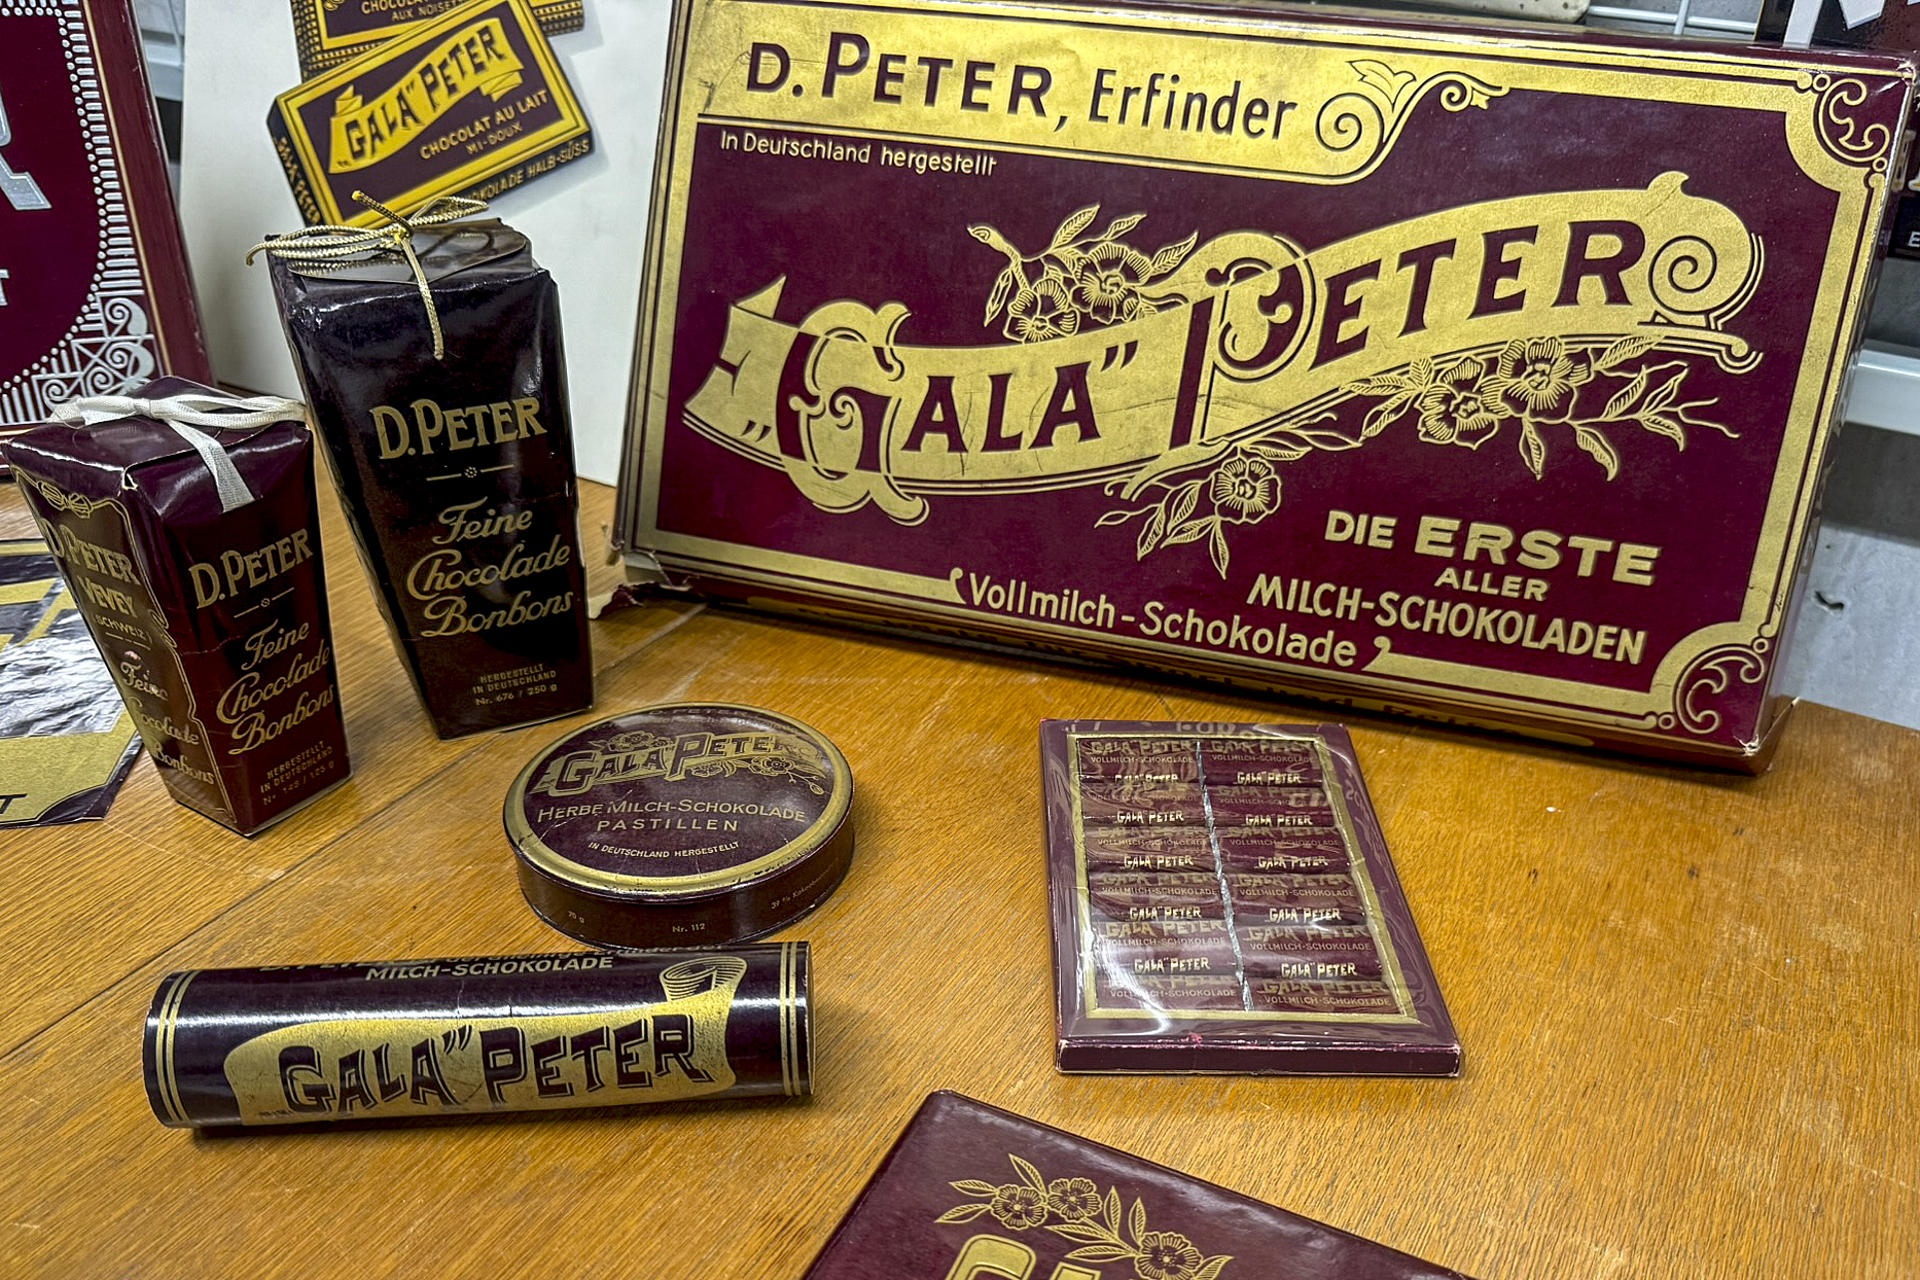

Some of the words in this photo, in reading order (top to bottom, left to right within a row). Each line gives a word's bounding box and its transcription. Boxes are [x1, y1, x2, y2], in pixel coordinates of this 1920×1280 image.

[422, 25, 507, 112] PETER
[746, 42, 804, 98] D.
[820, 31, 1069, 132] PETER,
[1088, 66, 1298, 142] Erfinder
[420, 116, 492, 160] CHOCOLAT
[494, 104, 516, 126] AU
[516, 89, 548, 114] LAIT
[719, 130, 740, 152] In
[743, 132, 871, 165] Deutschland
[880, 144, 998, 177] hergestellt
[1150, 219, 1648, 462] PETER
[431, 496, 534, 545] Feine
[406, 534, 571, 602] Chocolade
[1324, 508, 1398, 550] DIE
[1413, 514, 1665, 587] ERSTE
[1434, 566, 1550, 602] ALLER
[420, 589, 575, 639] Bonbons
[1245, 572, 1648, 667] MILCH-SCHOKOLADEN
[241, 618, 310, 671] Feine
[216, 640, 330, 724] Chocolade
[228, 684, 335, 756] Bonbons
[1267, 772, 1302, 784] PETER
[537, 803, 604, 823] HERBE
[606, 799, 807, 823] MILCH-SCHOKOLADE
[597, 819, 740, 833] PASTILLEN
[1148, 810, 1184, 824] PETER
[1276, 814, 1313, 827] PETER
[587, 840, 601, 853] IN
[600, 844, 671, 859] DEUTSCHLAND
[674, 840, 741, 858] HERGESTELLT
[1156, 854, 1194, 869] PETER
[672, 924, 689, 934] Nr.
[691, 922, 706, 933] 112
[1164, 906, 1203, 921] PETER
[365, 956, 615, 981] MILCH-SCHOKOLADE
[1170, 957, 1211, 974] PETER
[1317, 962, 1358, 978] PETER
[479, 1013, 716, 1104] PETER
